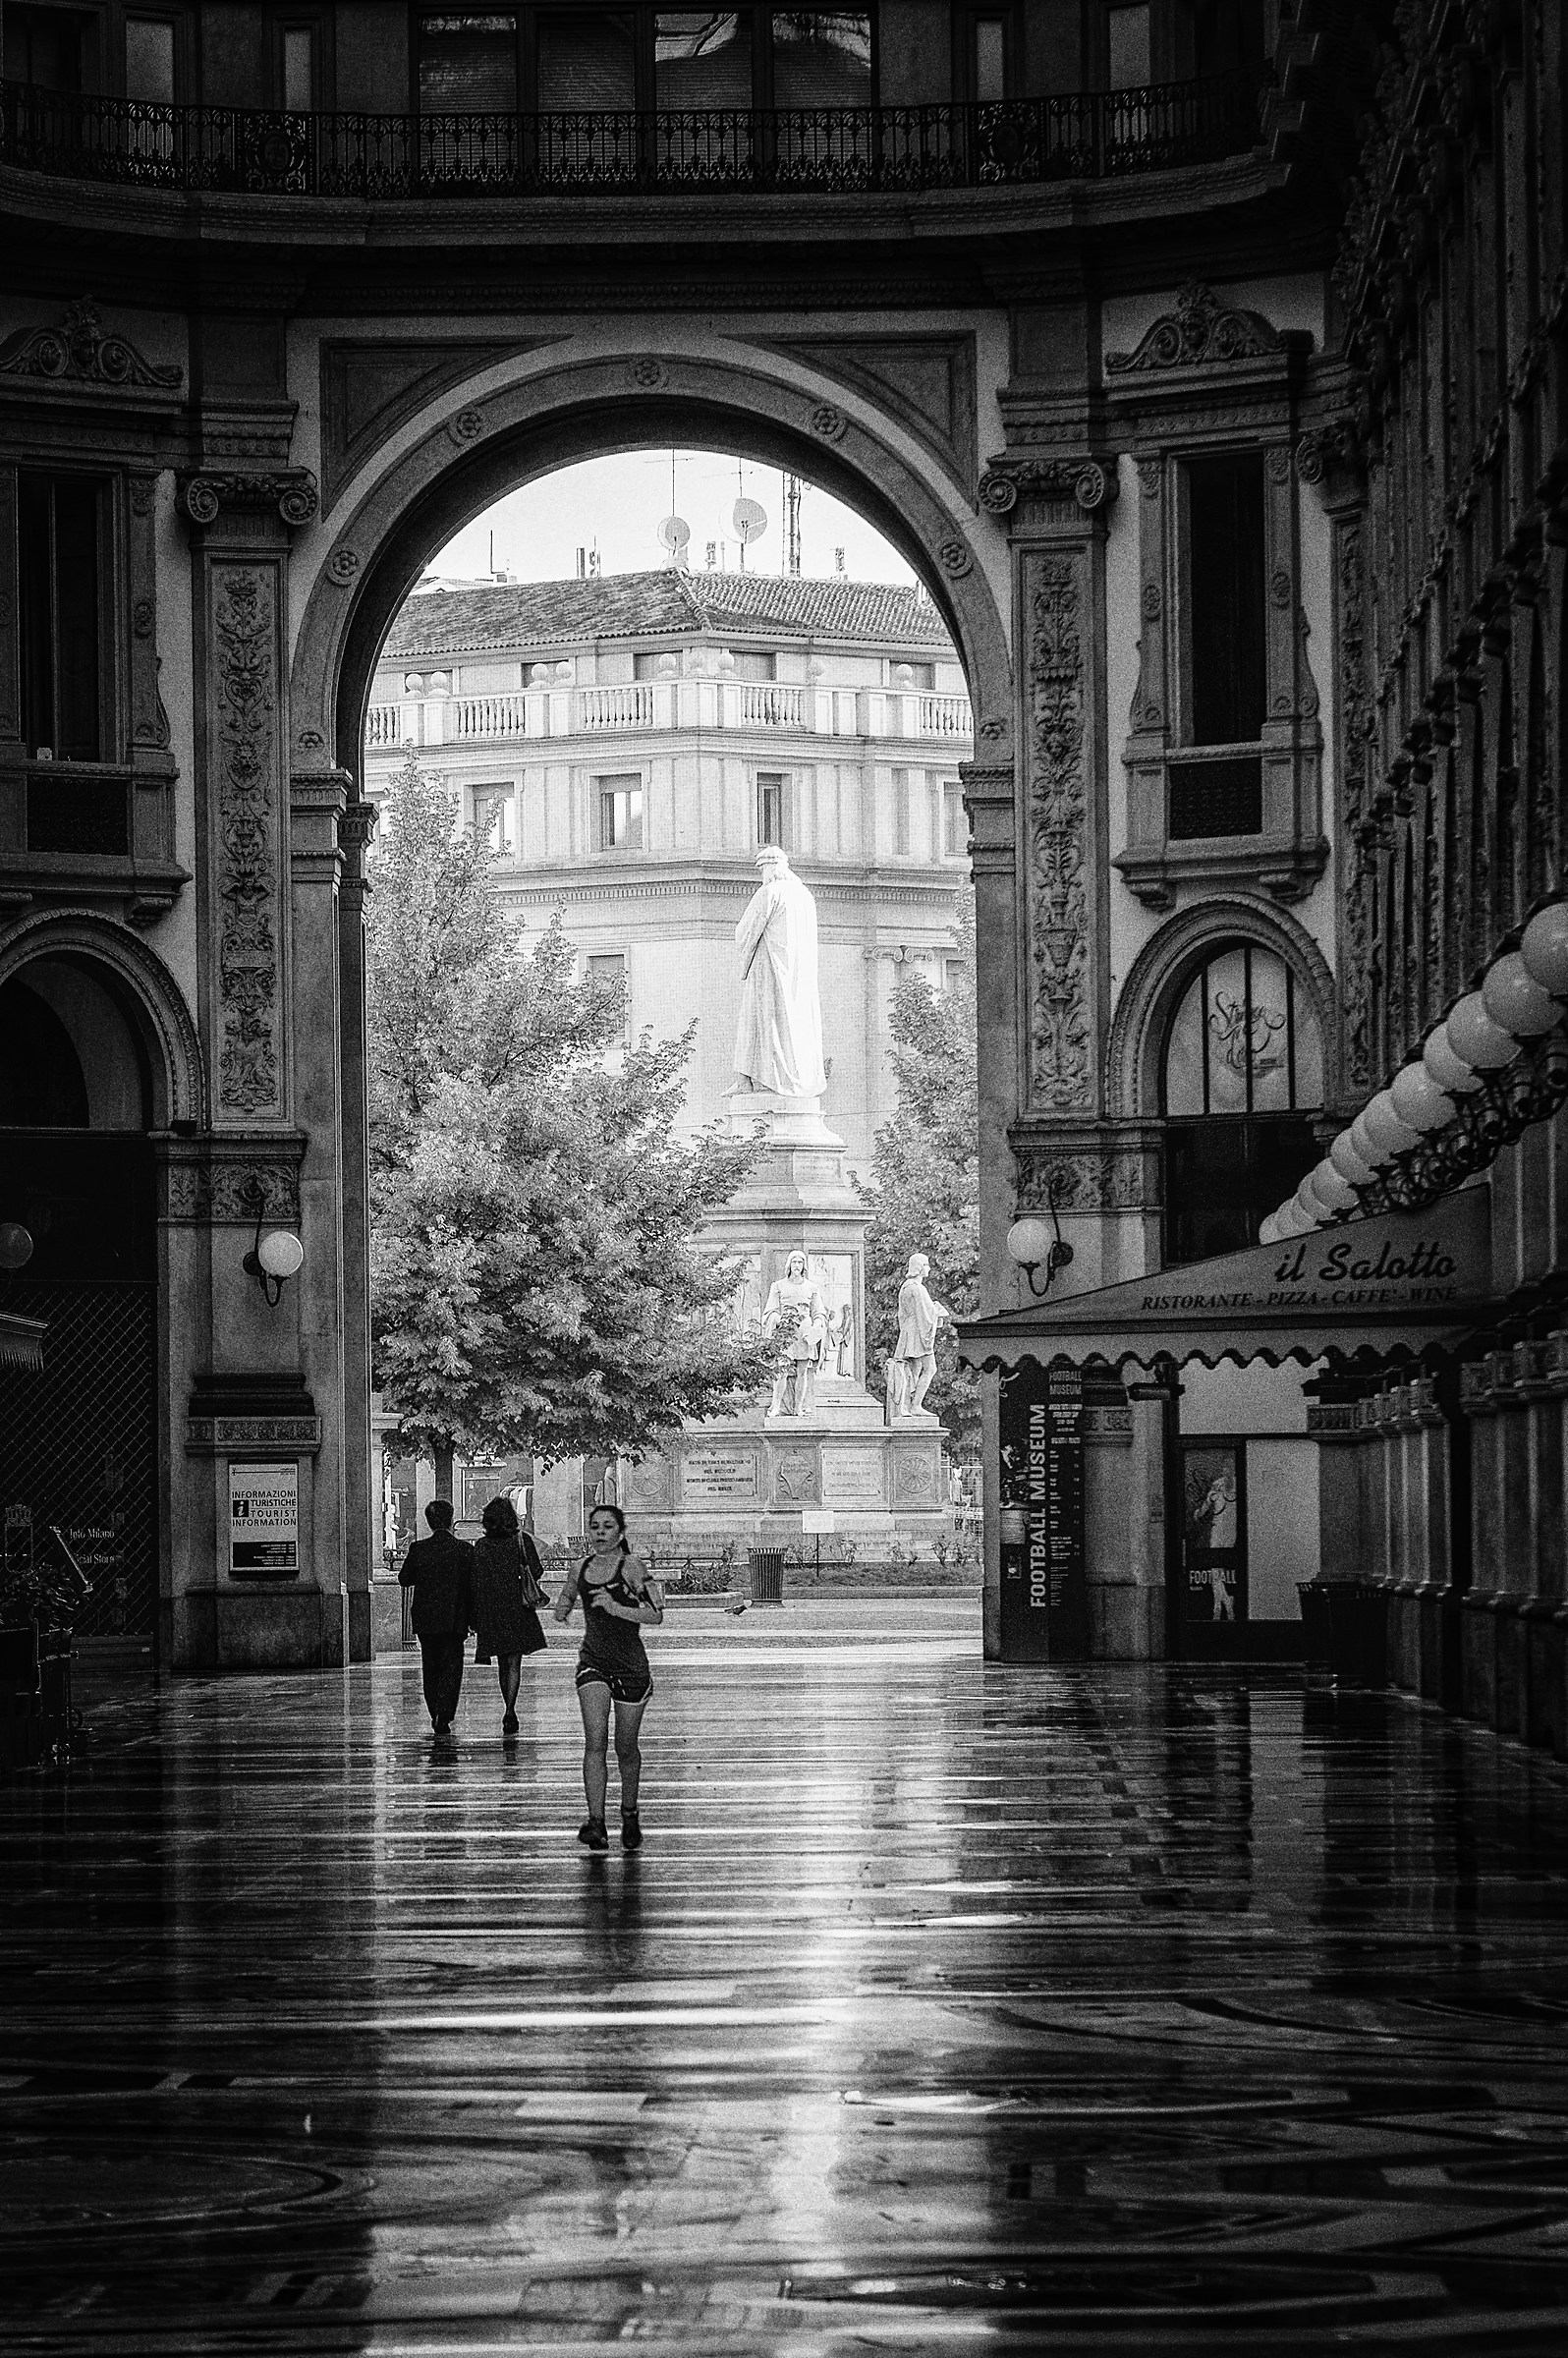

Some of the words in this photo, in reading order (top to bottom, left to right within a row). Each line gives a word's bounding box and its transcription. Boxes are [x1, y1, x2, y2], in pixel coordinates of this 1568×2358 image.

[1274, 1243, 1307, 1282] il
[1318, 1241, 1457, 1281] Salotto
[1142, 1293, 1253, 1310] RISTORANTE
[1266, 1291, 1317, 1306] PIZZA
[1411, 1286, 1457, 1302] WINE
[1029, 1404, 1046, 1500] MUSEUM
[87, 1528, 115, 1539] Milano
[1030, 1508, 1046, 1607] FOOTBALL
[1189, 1569, 1237, 1584] FOOTALL
